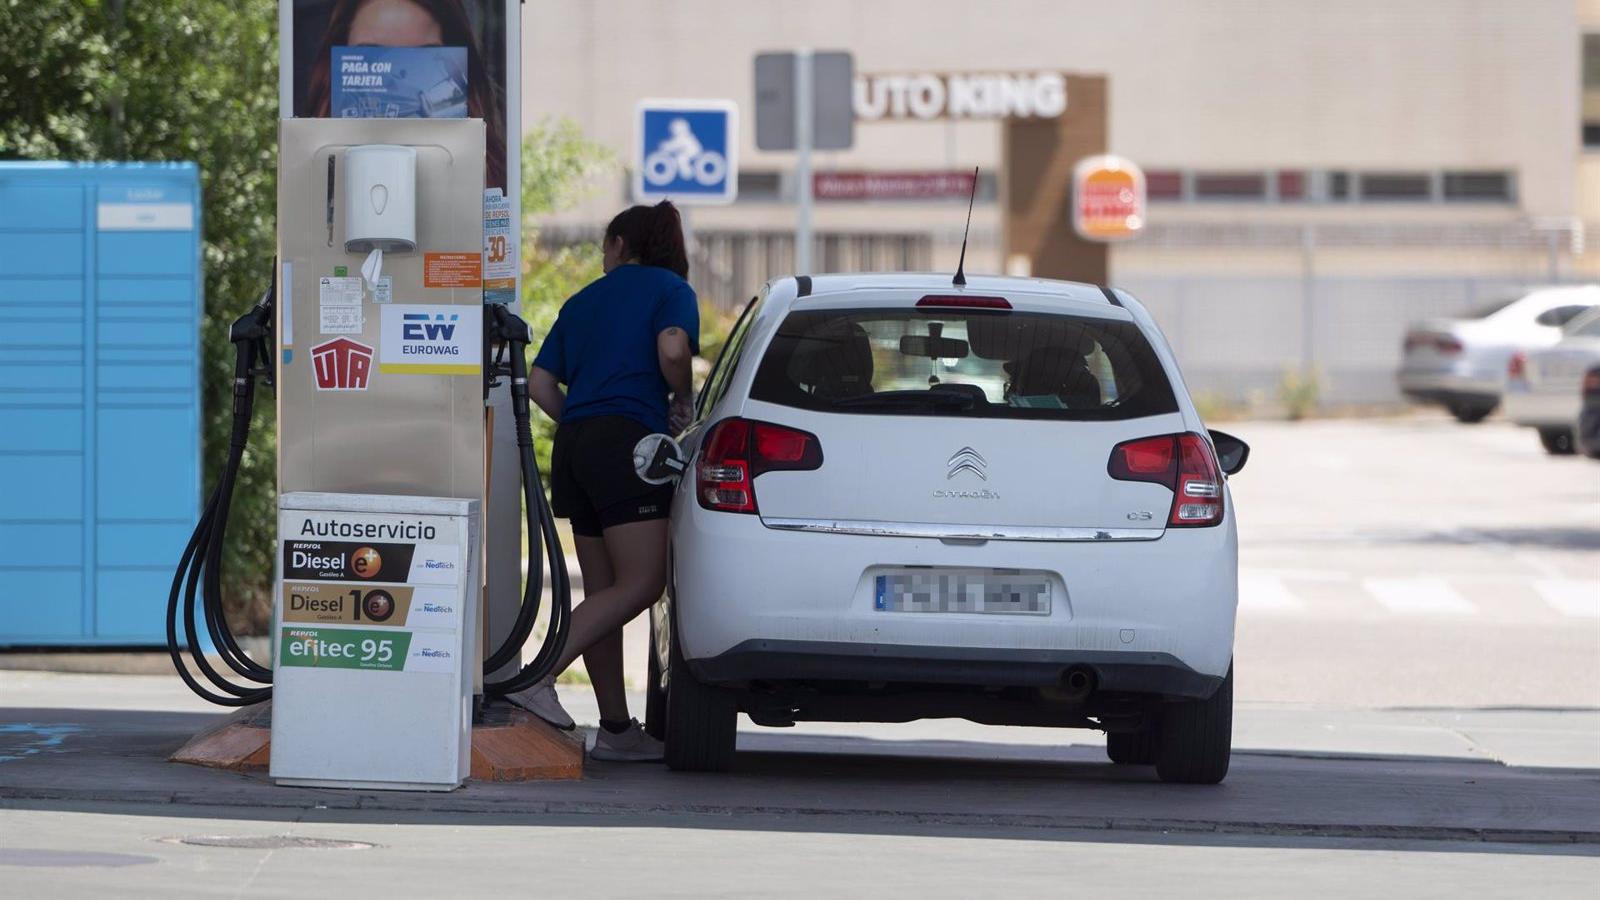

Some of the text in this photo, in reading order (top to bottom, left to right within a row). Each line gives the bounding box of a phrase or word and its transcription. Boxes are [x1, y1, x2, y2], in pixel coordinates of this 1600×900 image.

[341, 62, 392, 73] PAGA CON
[342, 75, 383, 86] TARJETA
[852, 73, 1067, 118] UTO KING
[403, 313, 459, 340] EW
[402, 345, 459, 355] EUROWAG
[311, 338, 373, 388] UTA
[933, 489, 1000, 500] CITROËN
[301, 518, 436, 540] Autoservicio
[292, 551, 345, 570] Diesel
[291, 589, 395, 622] Diesel 10
[289, 639, 392, 662] efitec 95
